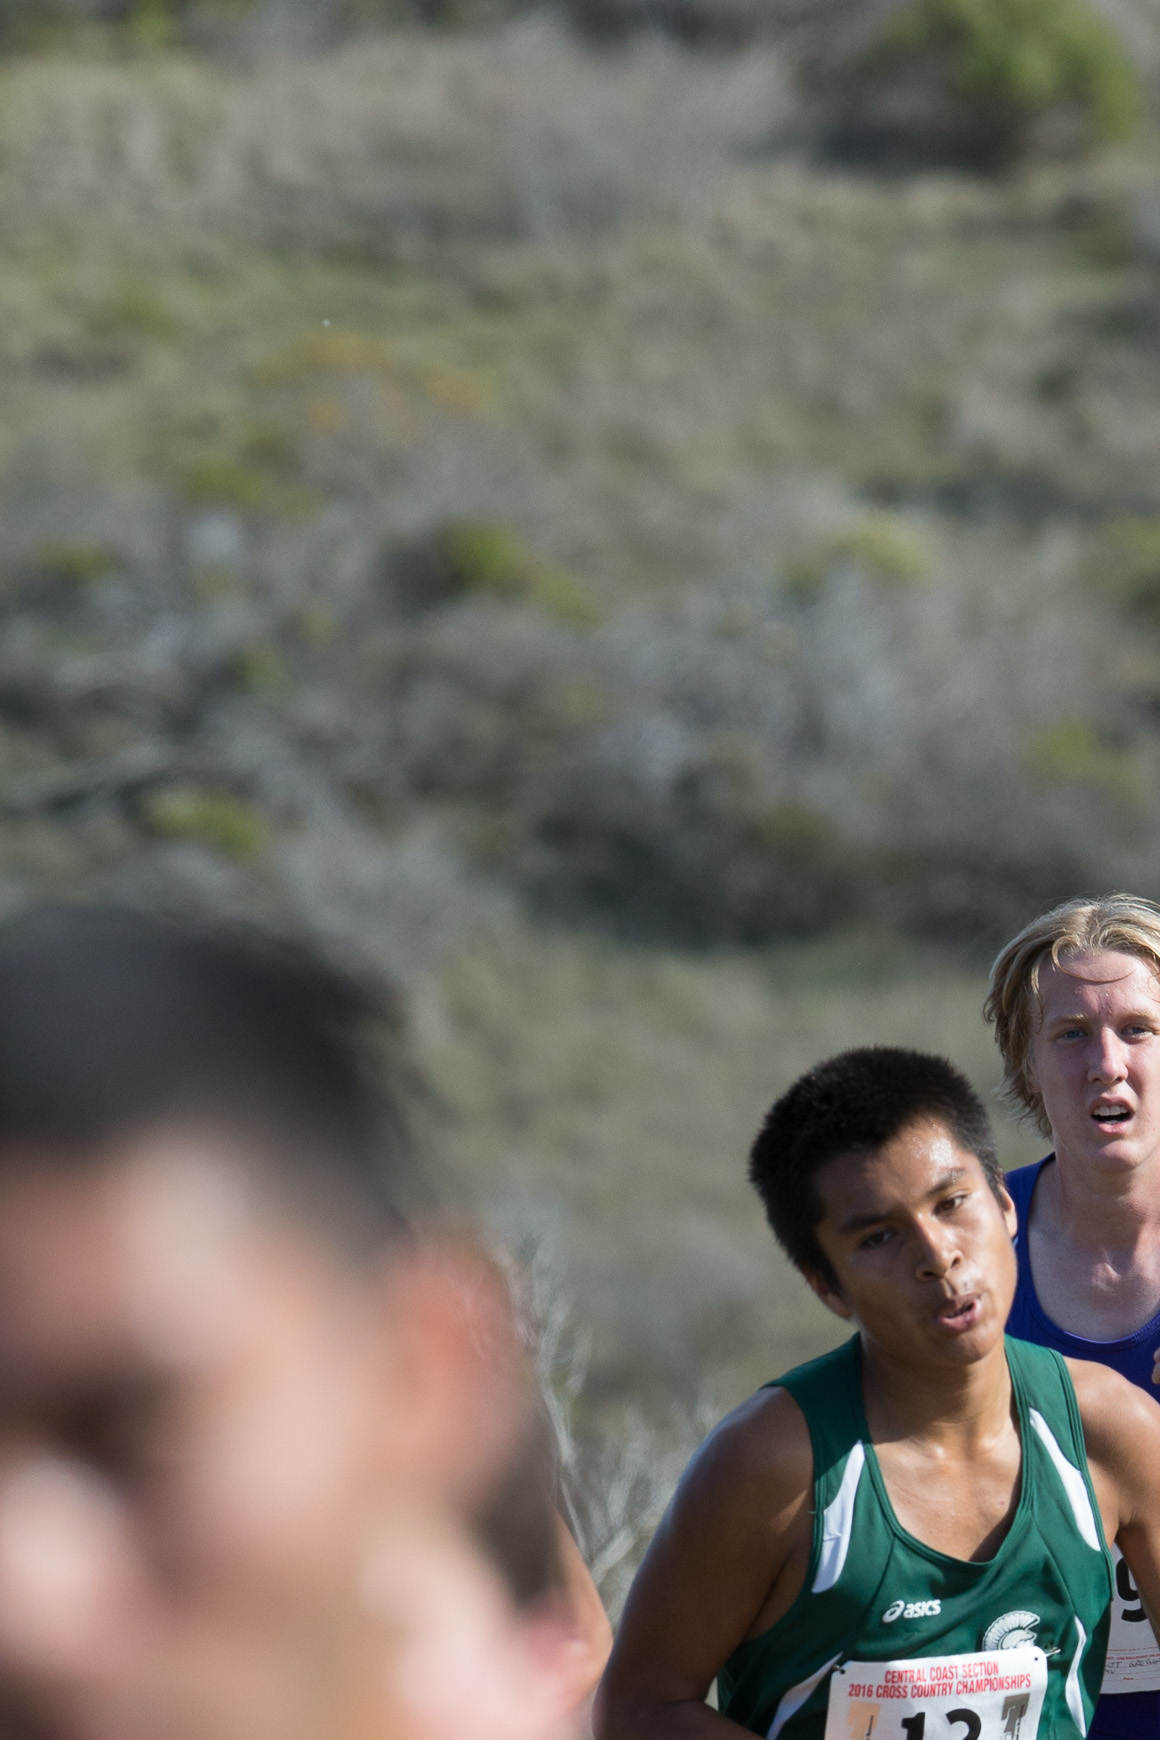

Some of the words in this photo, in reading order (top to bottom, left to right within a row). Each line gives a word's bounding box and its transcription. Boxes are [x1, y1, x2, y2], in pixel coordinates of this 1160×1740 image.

[903, 1599, 941, 1618] asics
[884, 1669, 926, 1684] CENTRAL
[929, 1665, 959, 1682] COAST
[962, 1660, 999, 1678] SECTION
[848, 1683, 873, 1698] 2016
[875, 1682, 908, 1699] CROSS
[910, 1681, 953, 1698] COUNTRY
[956, 1673, 1032, 1695] CHAMPIONSHIPS
